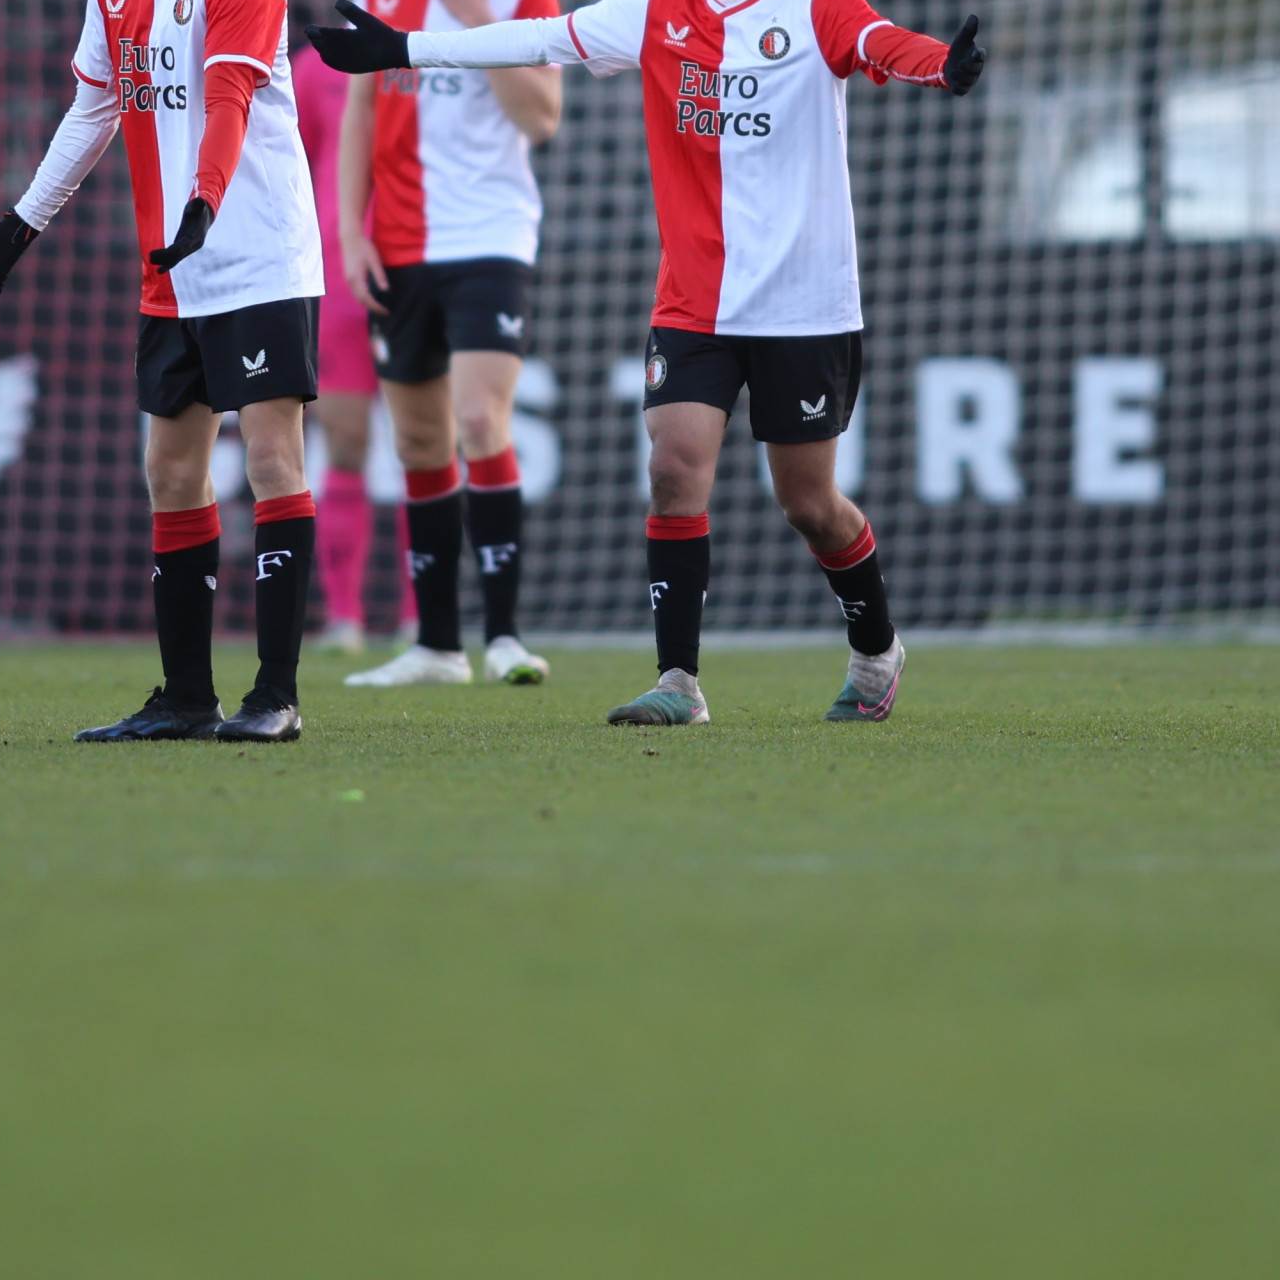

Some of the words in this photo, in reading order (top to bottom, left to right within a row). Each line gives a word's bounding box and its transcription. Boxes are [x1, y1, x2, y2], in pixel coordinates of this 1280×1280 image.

[118, 38, 175, 73] Euro
[119, 77, 187, 112] Parcs
[382, 68, 463, 96] Parcs
[679, 61, 758, 99] Euro
[677, 99, 771, 137] Parcs
[256, 549, 292, 581] F
[478, 541, 517, 573] F
